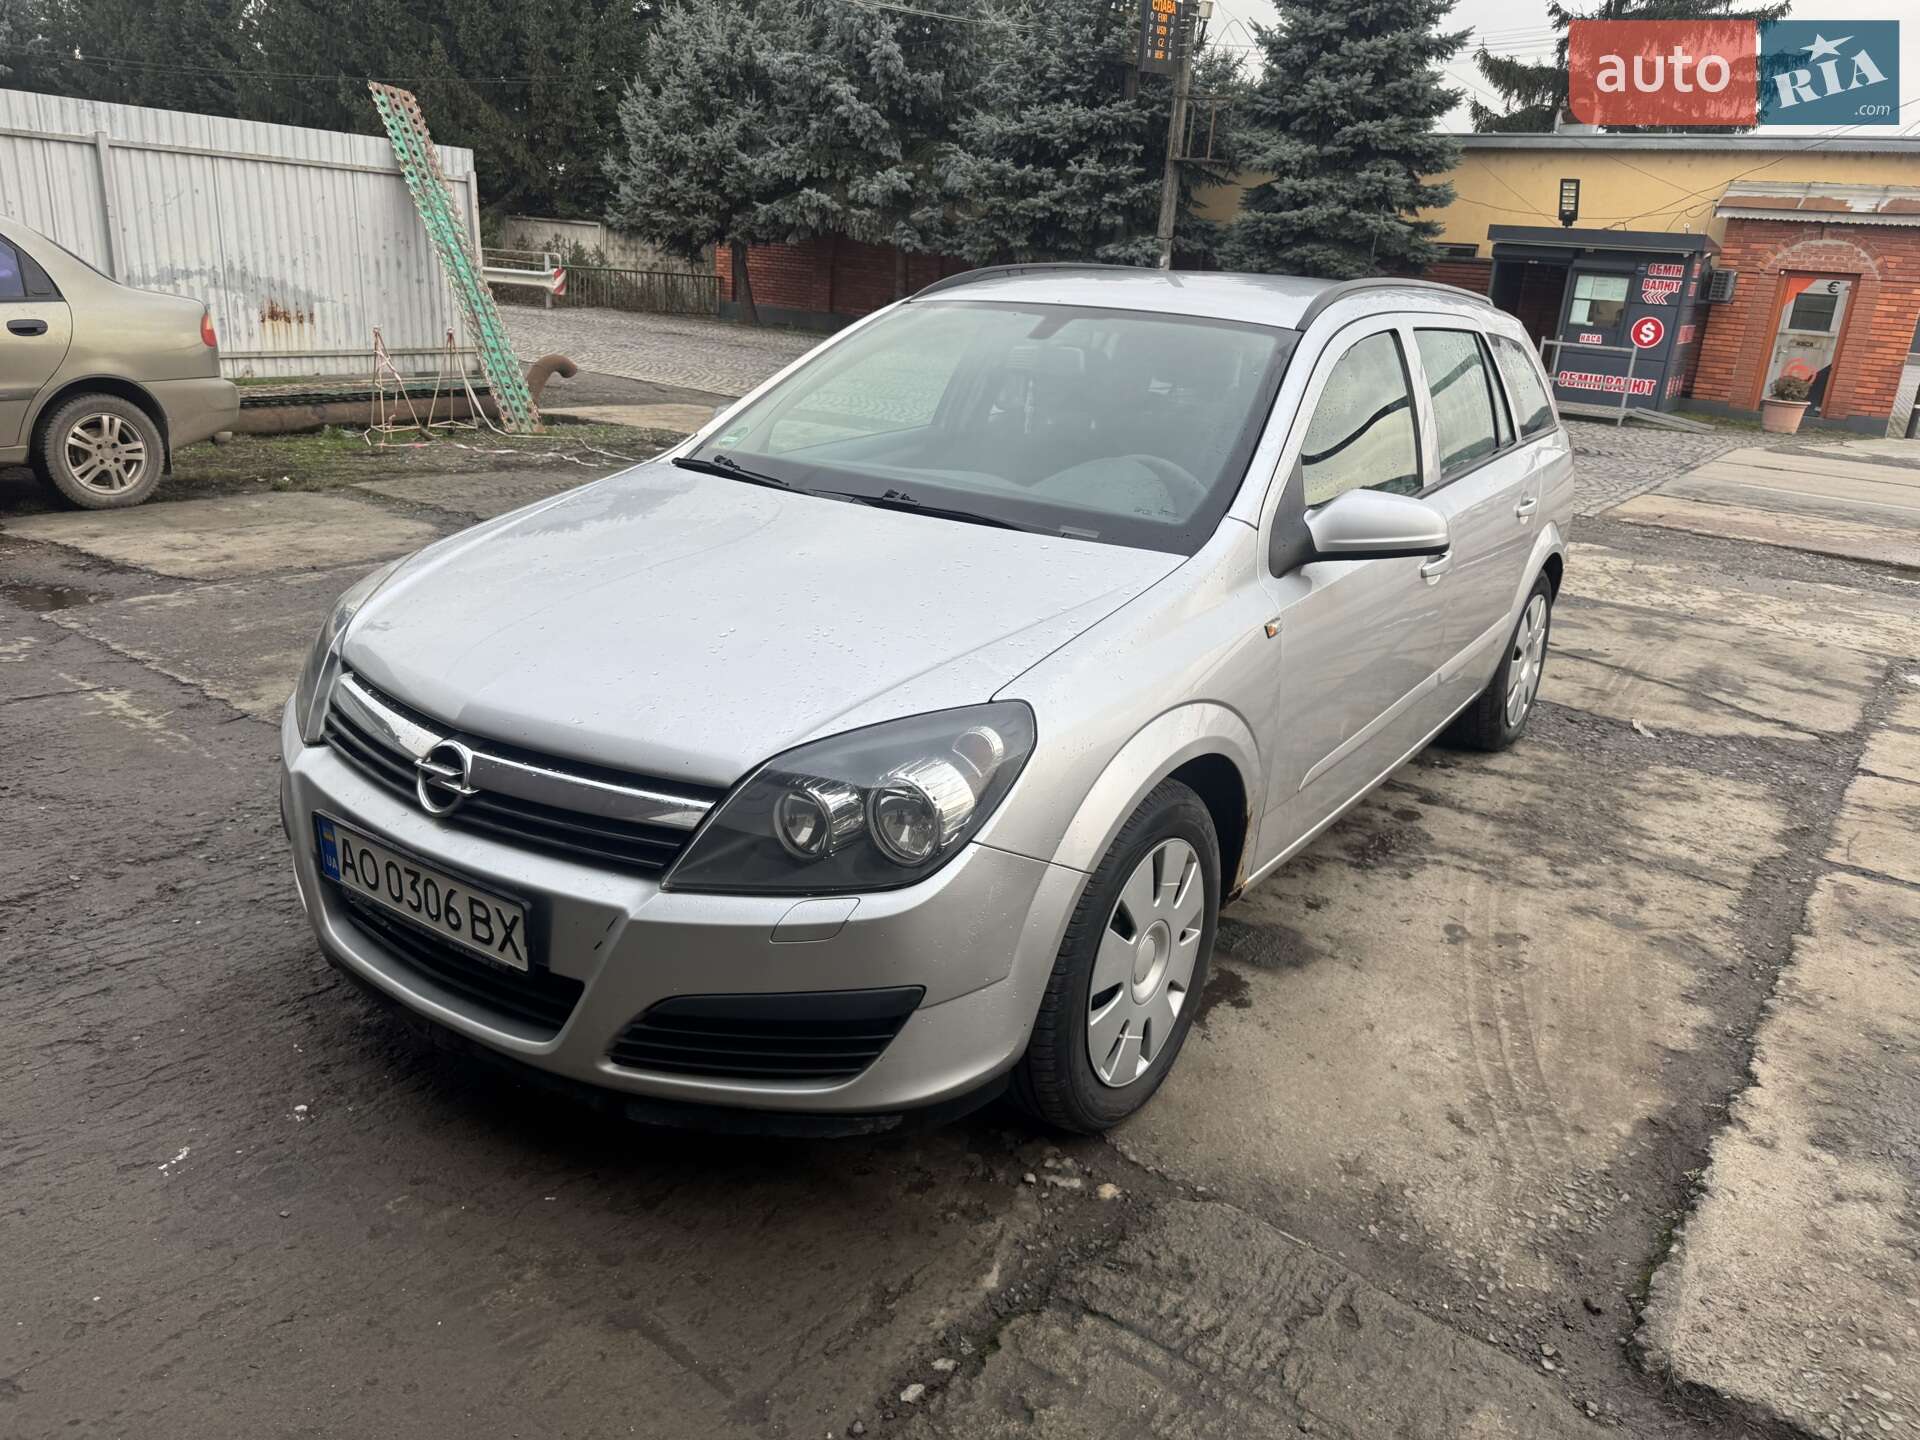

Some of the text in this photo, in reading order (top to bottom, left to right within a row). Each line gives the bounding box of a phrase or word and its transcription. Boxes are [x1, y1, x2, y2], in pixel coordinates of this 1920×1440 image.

[1648, 263, 1684, 277] ОБМІН
[1642, 278, 1683, 293] ВАЛЮТ
[1558, 370, 1604, 390] ОБМІН
[325, 854, 338, 870] UA
[341, 838, 380, 892] AO
[385, 860, 462, 931] 0306
[469, 895, 523, 961] BX
